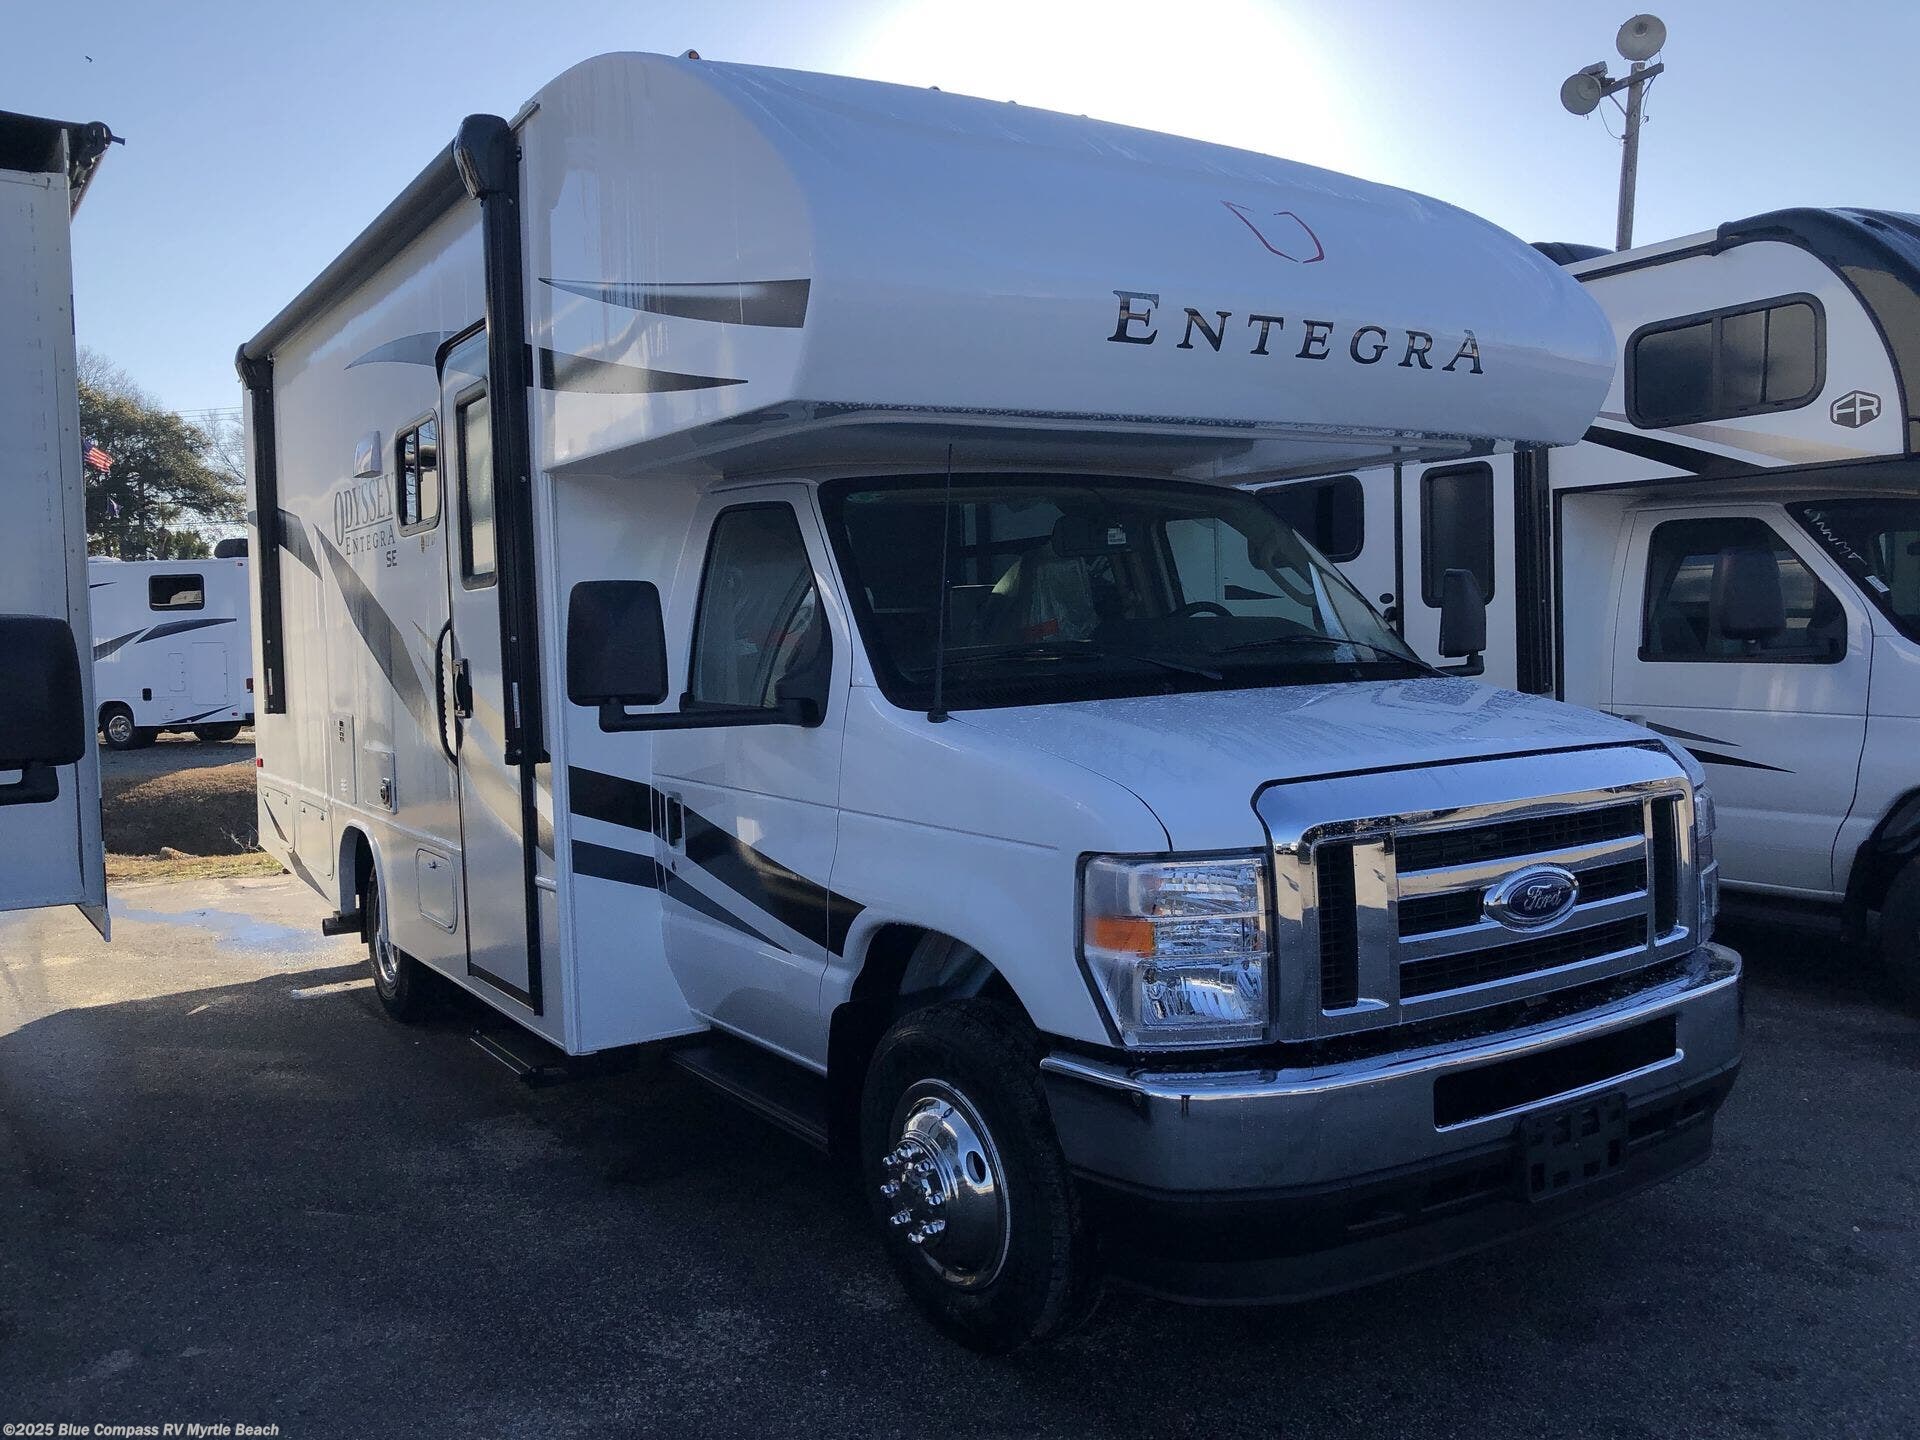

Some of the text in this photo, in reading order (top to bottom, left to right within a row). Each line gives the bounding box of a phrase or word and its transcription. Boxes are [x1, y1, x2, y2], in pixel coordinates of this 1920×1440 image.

[1107, 289, 1484, 374] ENTEGRA
[1832, 392, 1880, 427] FR
[334, 472, 395, 547] ODYSSEY
[345, 524, 396, 556] ENTEGRA
[386, 549, 398, 568] SE
[1523, 883, 1563, 912] Ford
